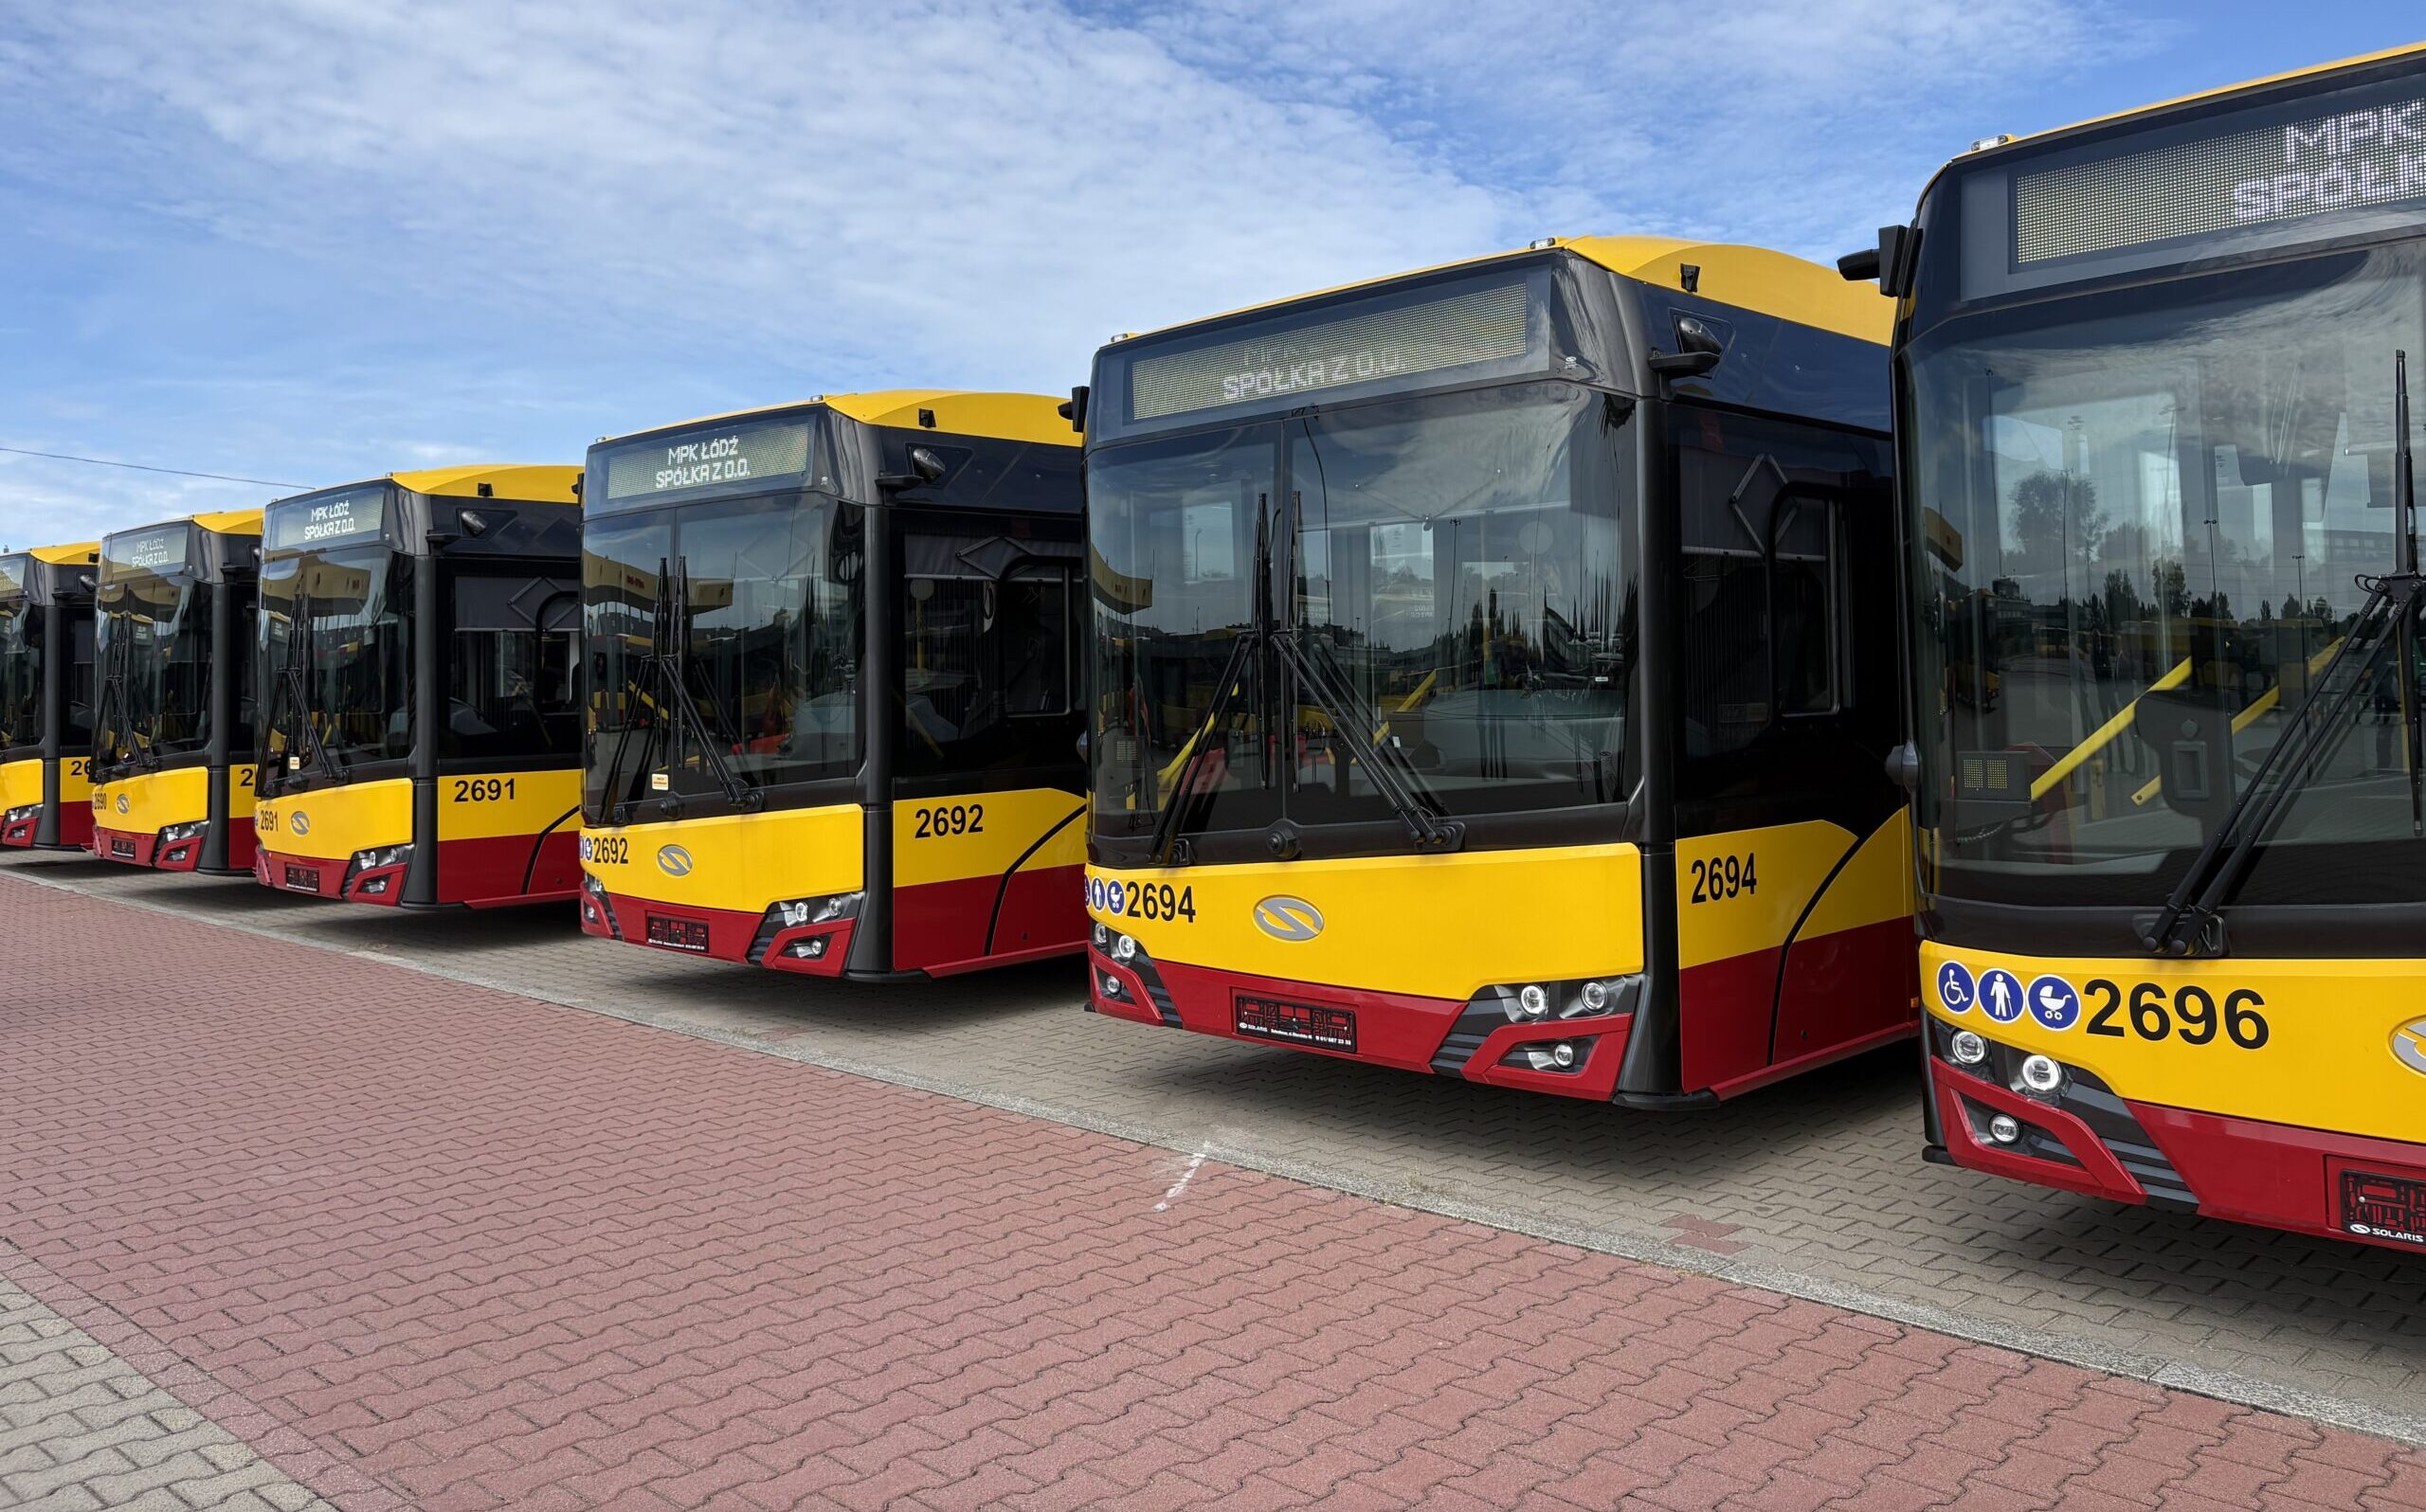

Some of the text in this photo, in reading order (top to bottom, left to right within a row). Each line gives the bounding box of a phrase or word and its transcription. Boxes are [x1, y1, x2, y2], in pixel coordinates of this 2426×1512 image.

[2286, 101, 2421, 163] MPK
[1222, 360, 1326, 400] SPÓŁKA
[1331, 355, 1349, 382] Z
[667, 435, 739, 465] MPK ŁÓDŹ
[655, 458, 751, 489] SPÓŁKA Z O.O.
[311, 499, 350, 523] MPK ŁÓDŹ
[304, 520, 335, 540] SPÓŁKA
[335, 519, 340, 535] Z
[71, 759, 92, 776] 26
[454, 778, 516, 803] 2691
[260, 810, 279, 832] 2691
[914, 803, 985, 839] 2692
[593, 837, 629, 864] 2692
[1691, 852, 1757, 905] 2694
[1126, 880, 1197, 924] 2694
[2083, 978, 2271, 1050] 2696
[2372, 1228, 2424, 1243] SOLARIS
